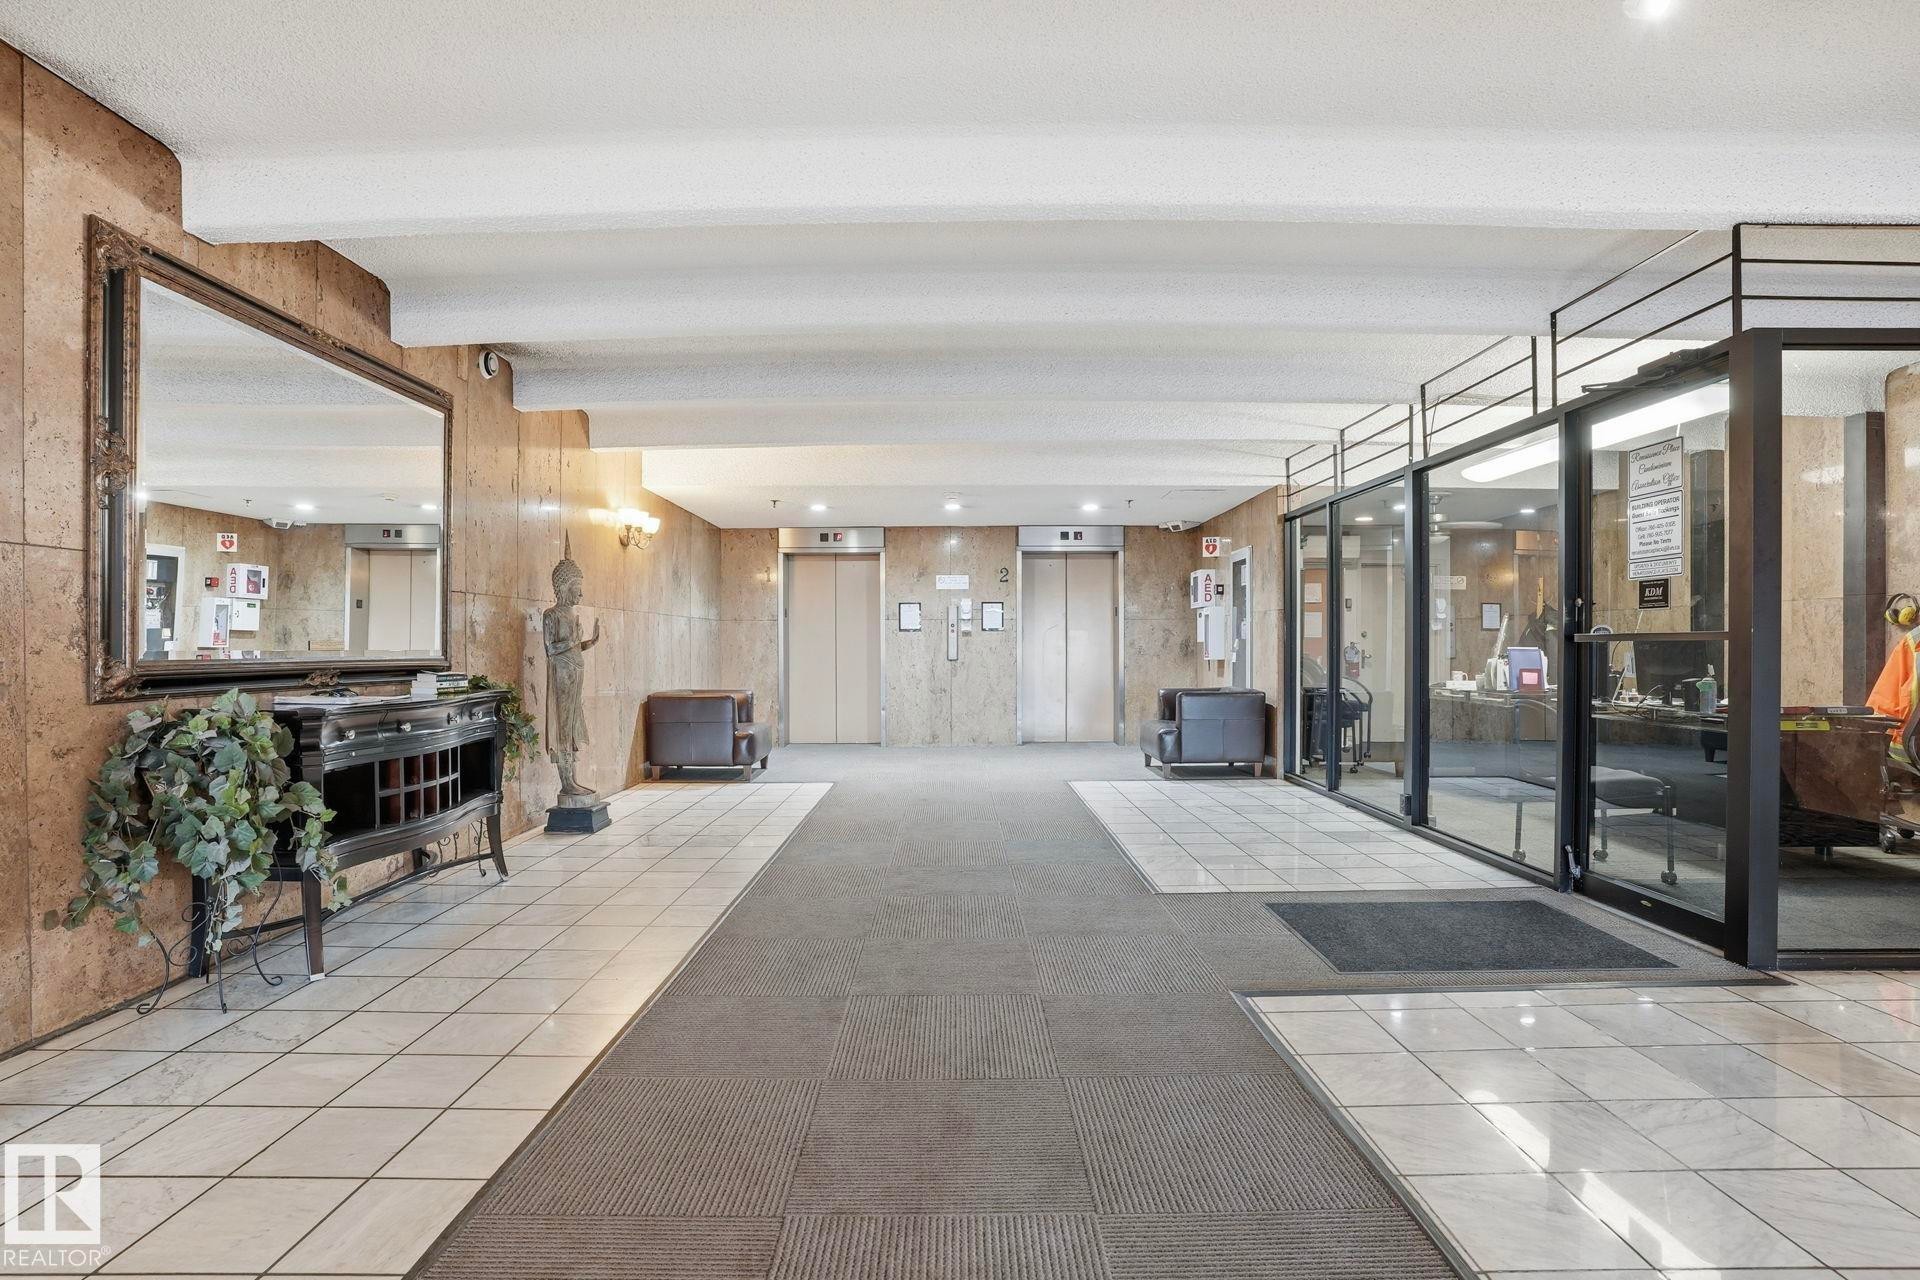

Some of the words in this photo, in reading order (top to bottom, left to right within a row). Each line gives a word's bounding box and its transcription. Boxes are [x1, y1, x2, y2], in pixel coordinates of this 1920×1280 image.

[1631, 478, 1660, 491] Association
[1663, 472, 1680, 486] Office
[1632, 502, 1653, 511] BUILDING
[1654, 496, 1680, 506] OPERATOR
[1000, 567, 1009, 582] 2
[1644, 586, 1663, 597] KDM
